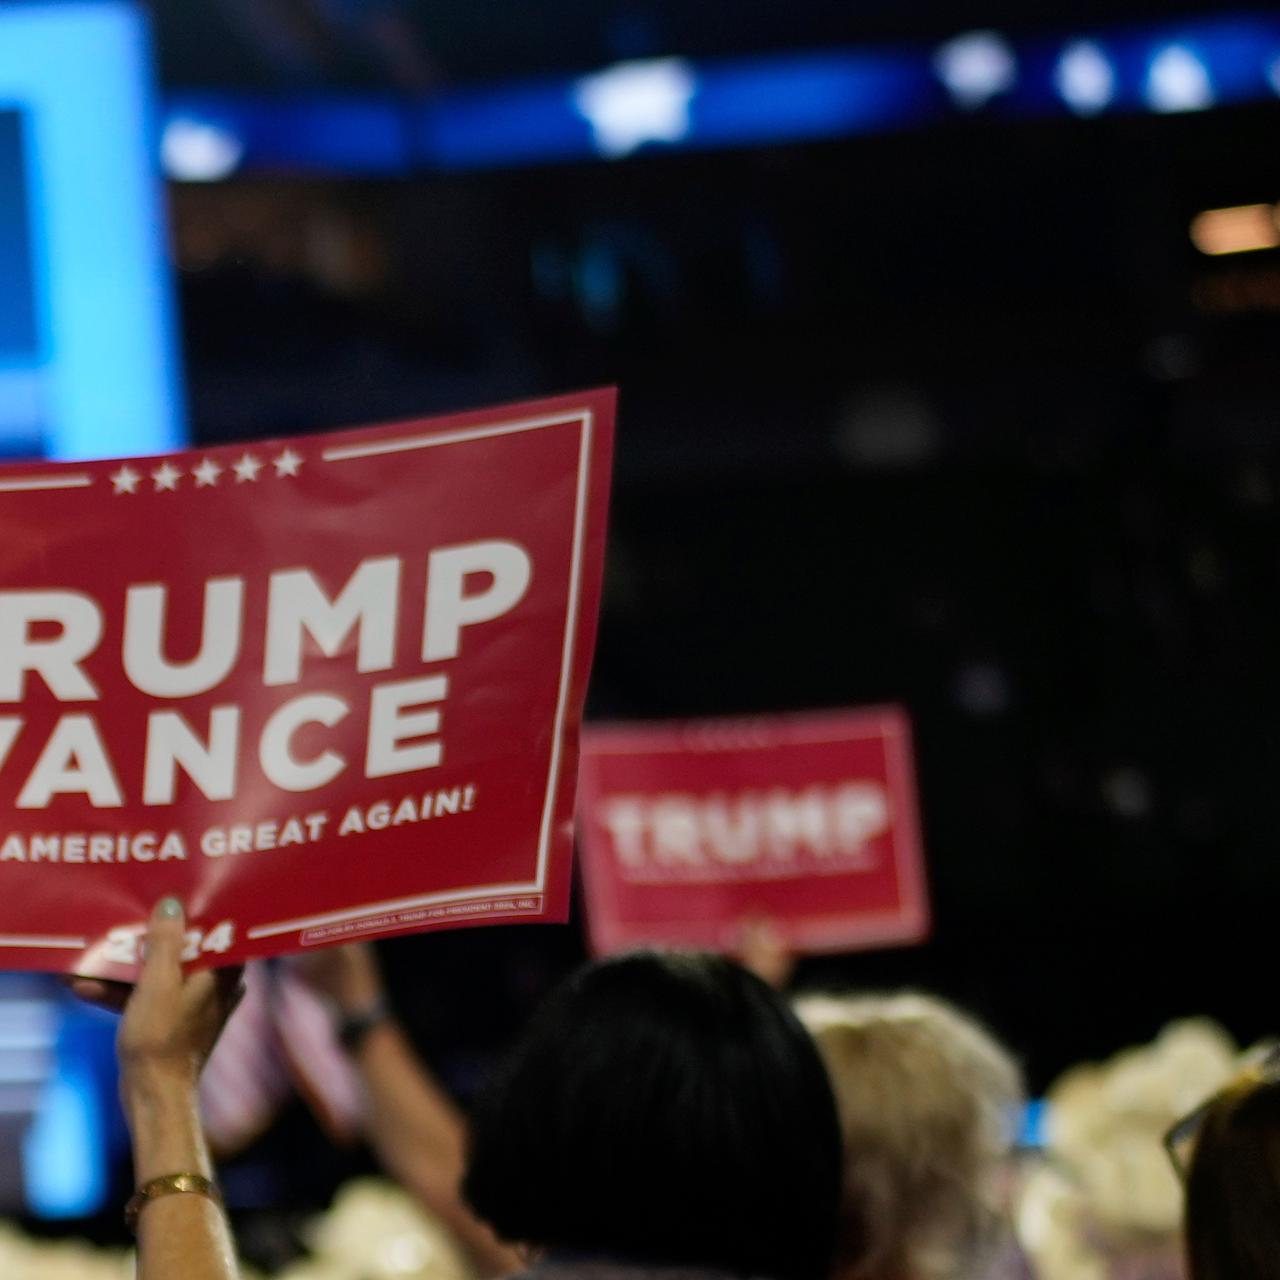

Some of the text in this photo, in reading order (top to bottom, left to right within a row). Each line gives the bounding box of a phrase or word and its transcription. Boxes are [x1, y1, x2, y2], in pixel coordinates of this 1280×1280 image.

[200, 815, 329, 861] GREAT
[339, 786, 475, 837] AGAIN!
[604, 782, 887, 868] TRUMP
[104, 921, 234, 965] 224
